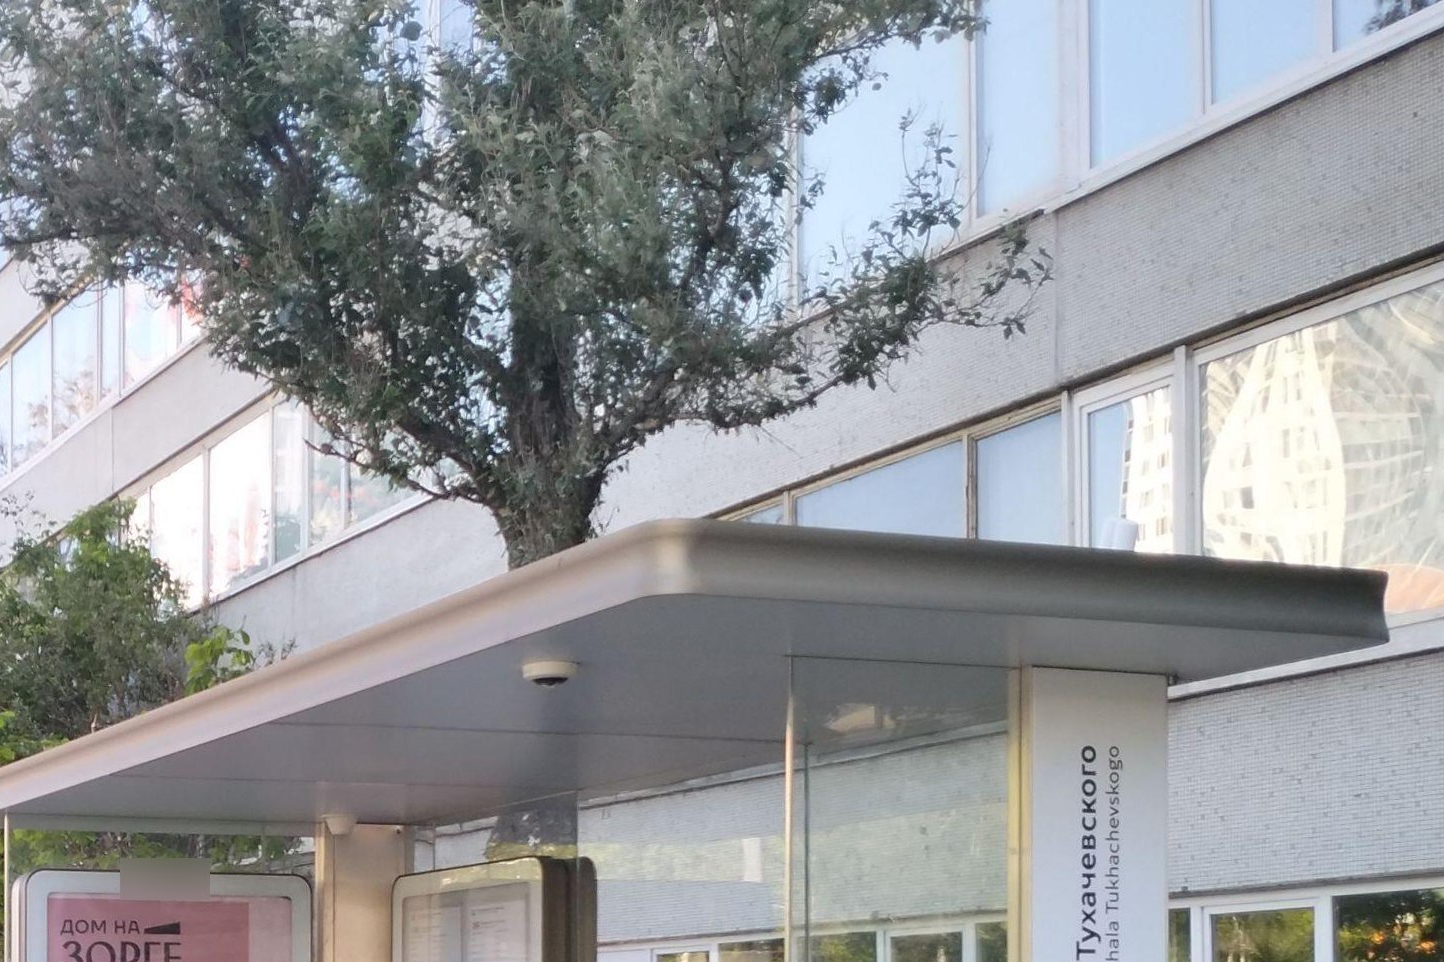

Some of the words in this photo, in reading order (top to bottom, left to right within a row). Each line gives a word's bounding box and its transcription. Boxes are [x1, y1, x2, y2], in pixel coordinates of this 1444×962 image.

[1076, 745, 1101, 961] Тухачевского
[1105, 745, 1123, 914] Tukhachevskogo
[60, 919, 107, 936] ДОМ
[114, 920, 141, 934] НА
